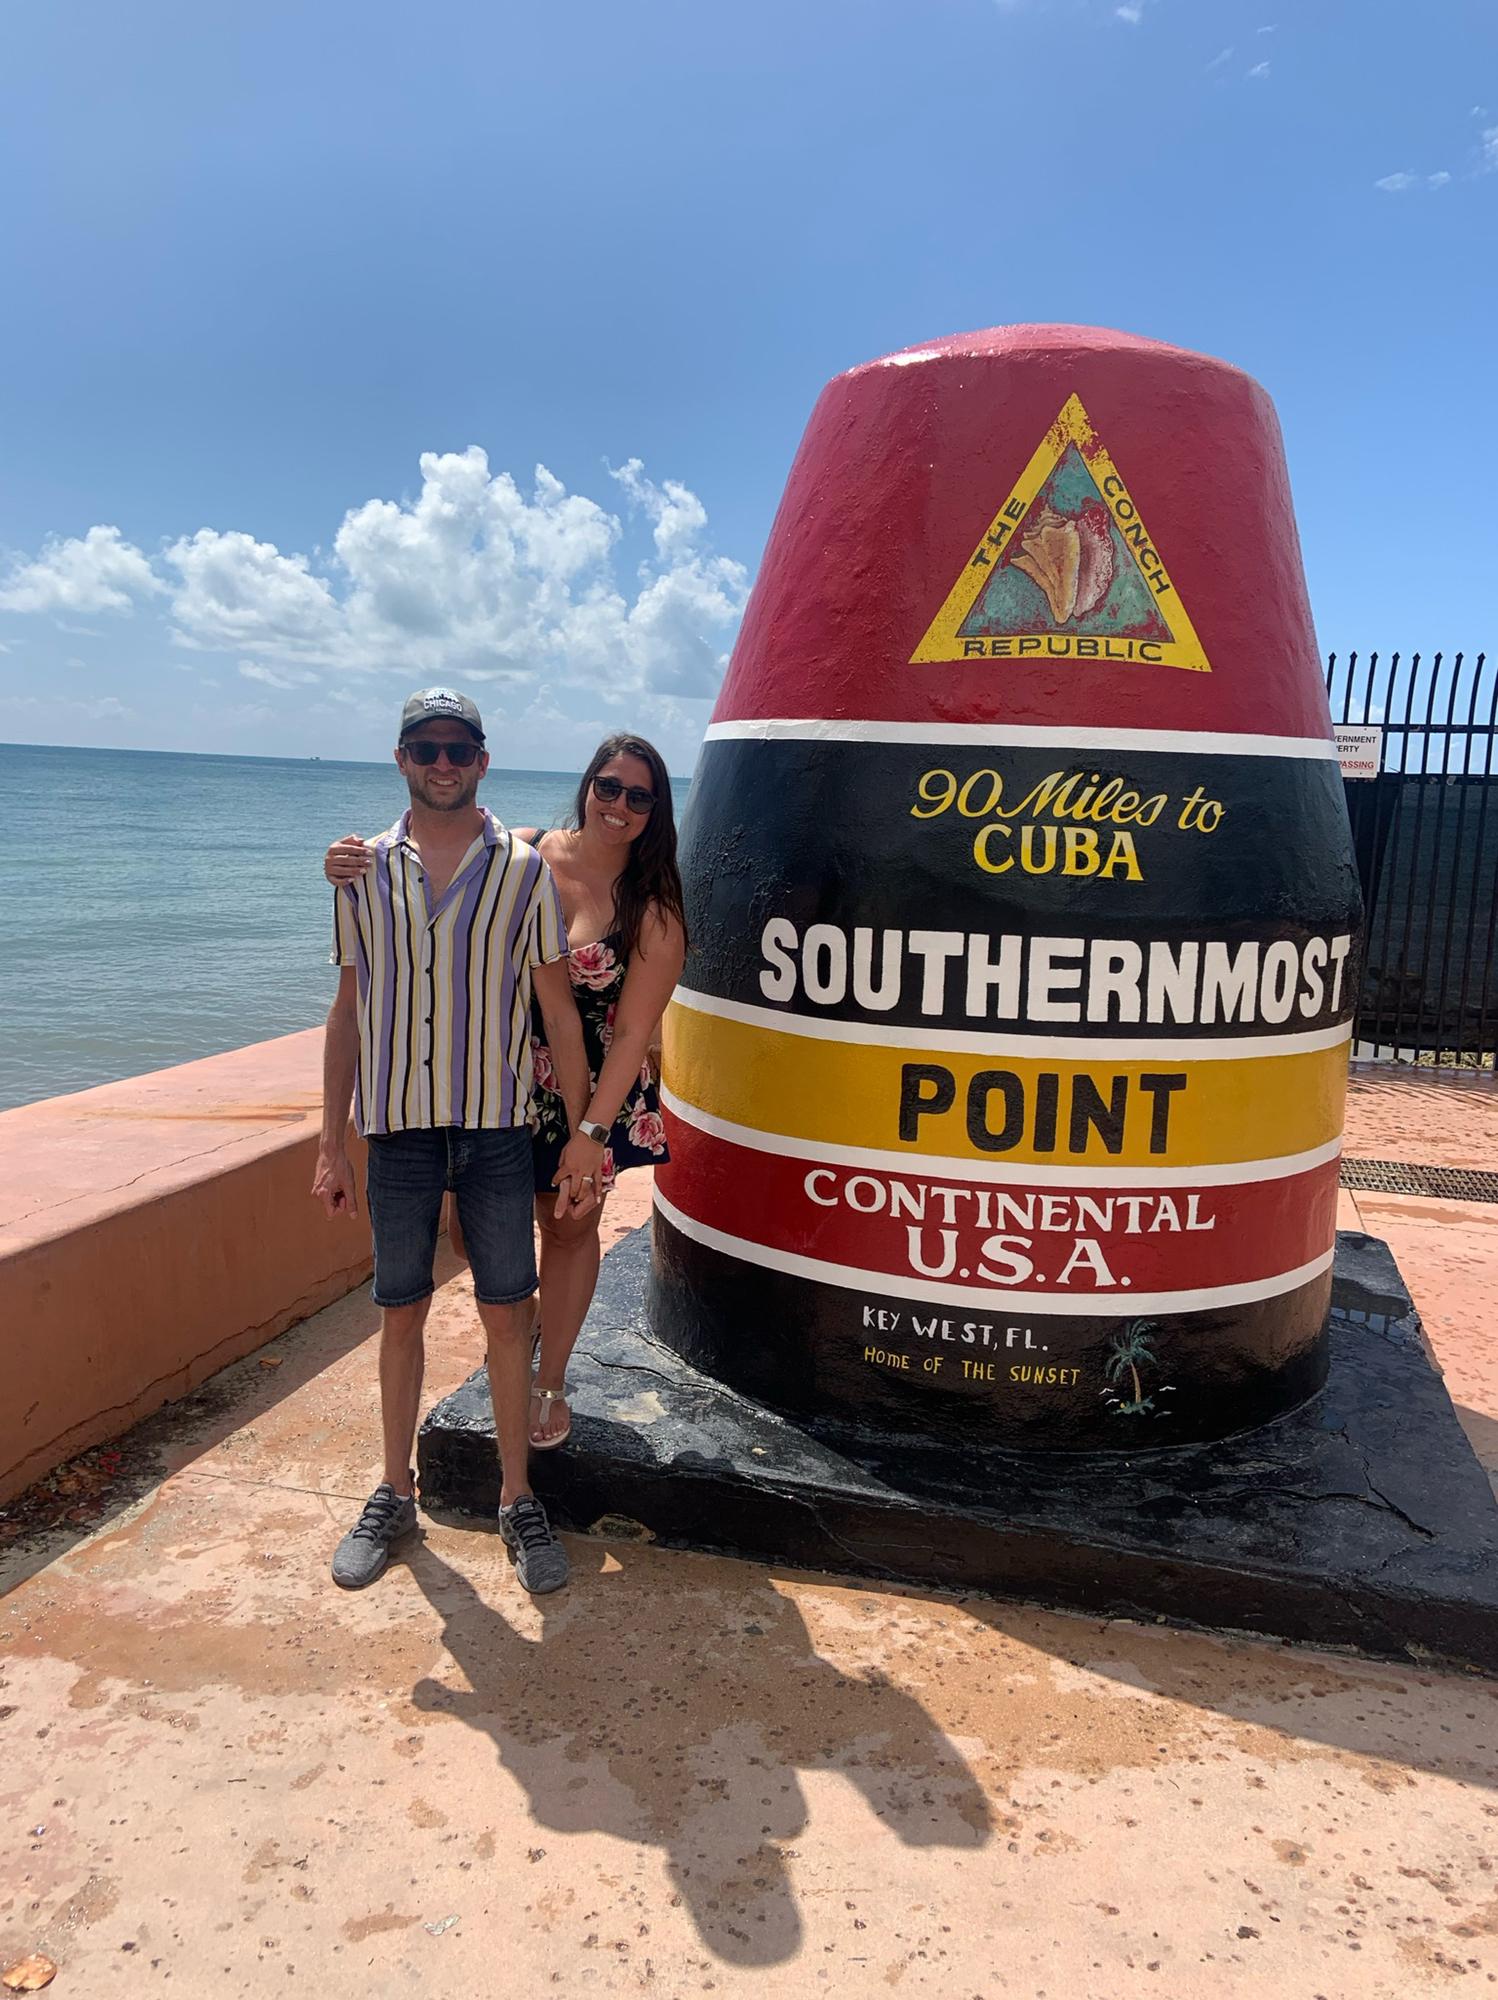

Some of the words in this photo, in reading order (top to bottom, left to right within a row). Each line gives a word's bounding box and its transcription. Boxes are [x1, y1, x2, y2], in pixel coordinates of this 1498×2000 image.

[971, 497, 1026, 569] THE
[1102, 475, 1171, 595] CONCH
[963, 637, 1163, 662] REPUBLIC
[423, 699, 463, 711] CHICAGO
[1336, 744, 1360, 752] ERTY
[910, 768, 998, 820] 90
[997, 770, 1168, 826] Miles
[1178, 786, 1226, 834] to
[972, 823, 1146, 882] CUBA
[759, 916, 1352, 1025] SOUTHERNMOST
[898, 1063, 1188, 1155] POINT
[803, 1169, 1217, 1234] CONTINENTAL
[906, 1225, 1133, 1288] U.S.A.
[862, 1305, 901, 1331] KEY
[911, 1315, 998, 1351] WEST,
[1005, 1327, 1049, 1351] FL.
[923, 1356, 944, 1374] OF
[961, 1359, 996, 1381] THE
[1008, 1365, 1081, 1386] SUNSET
